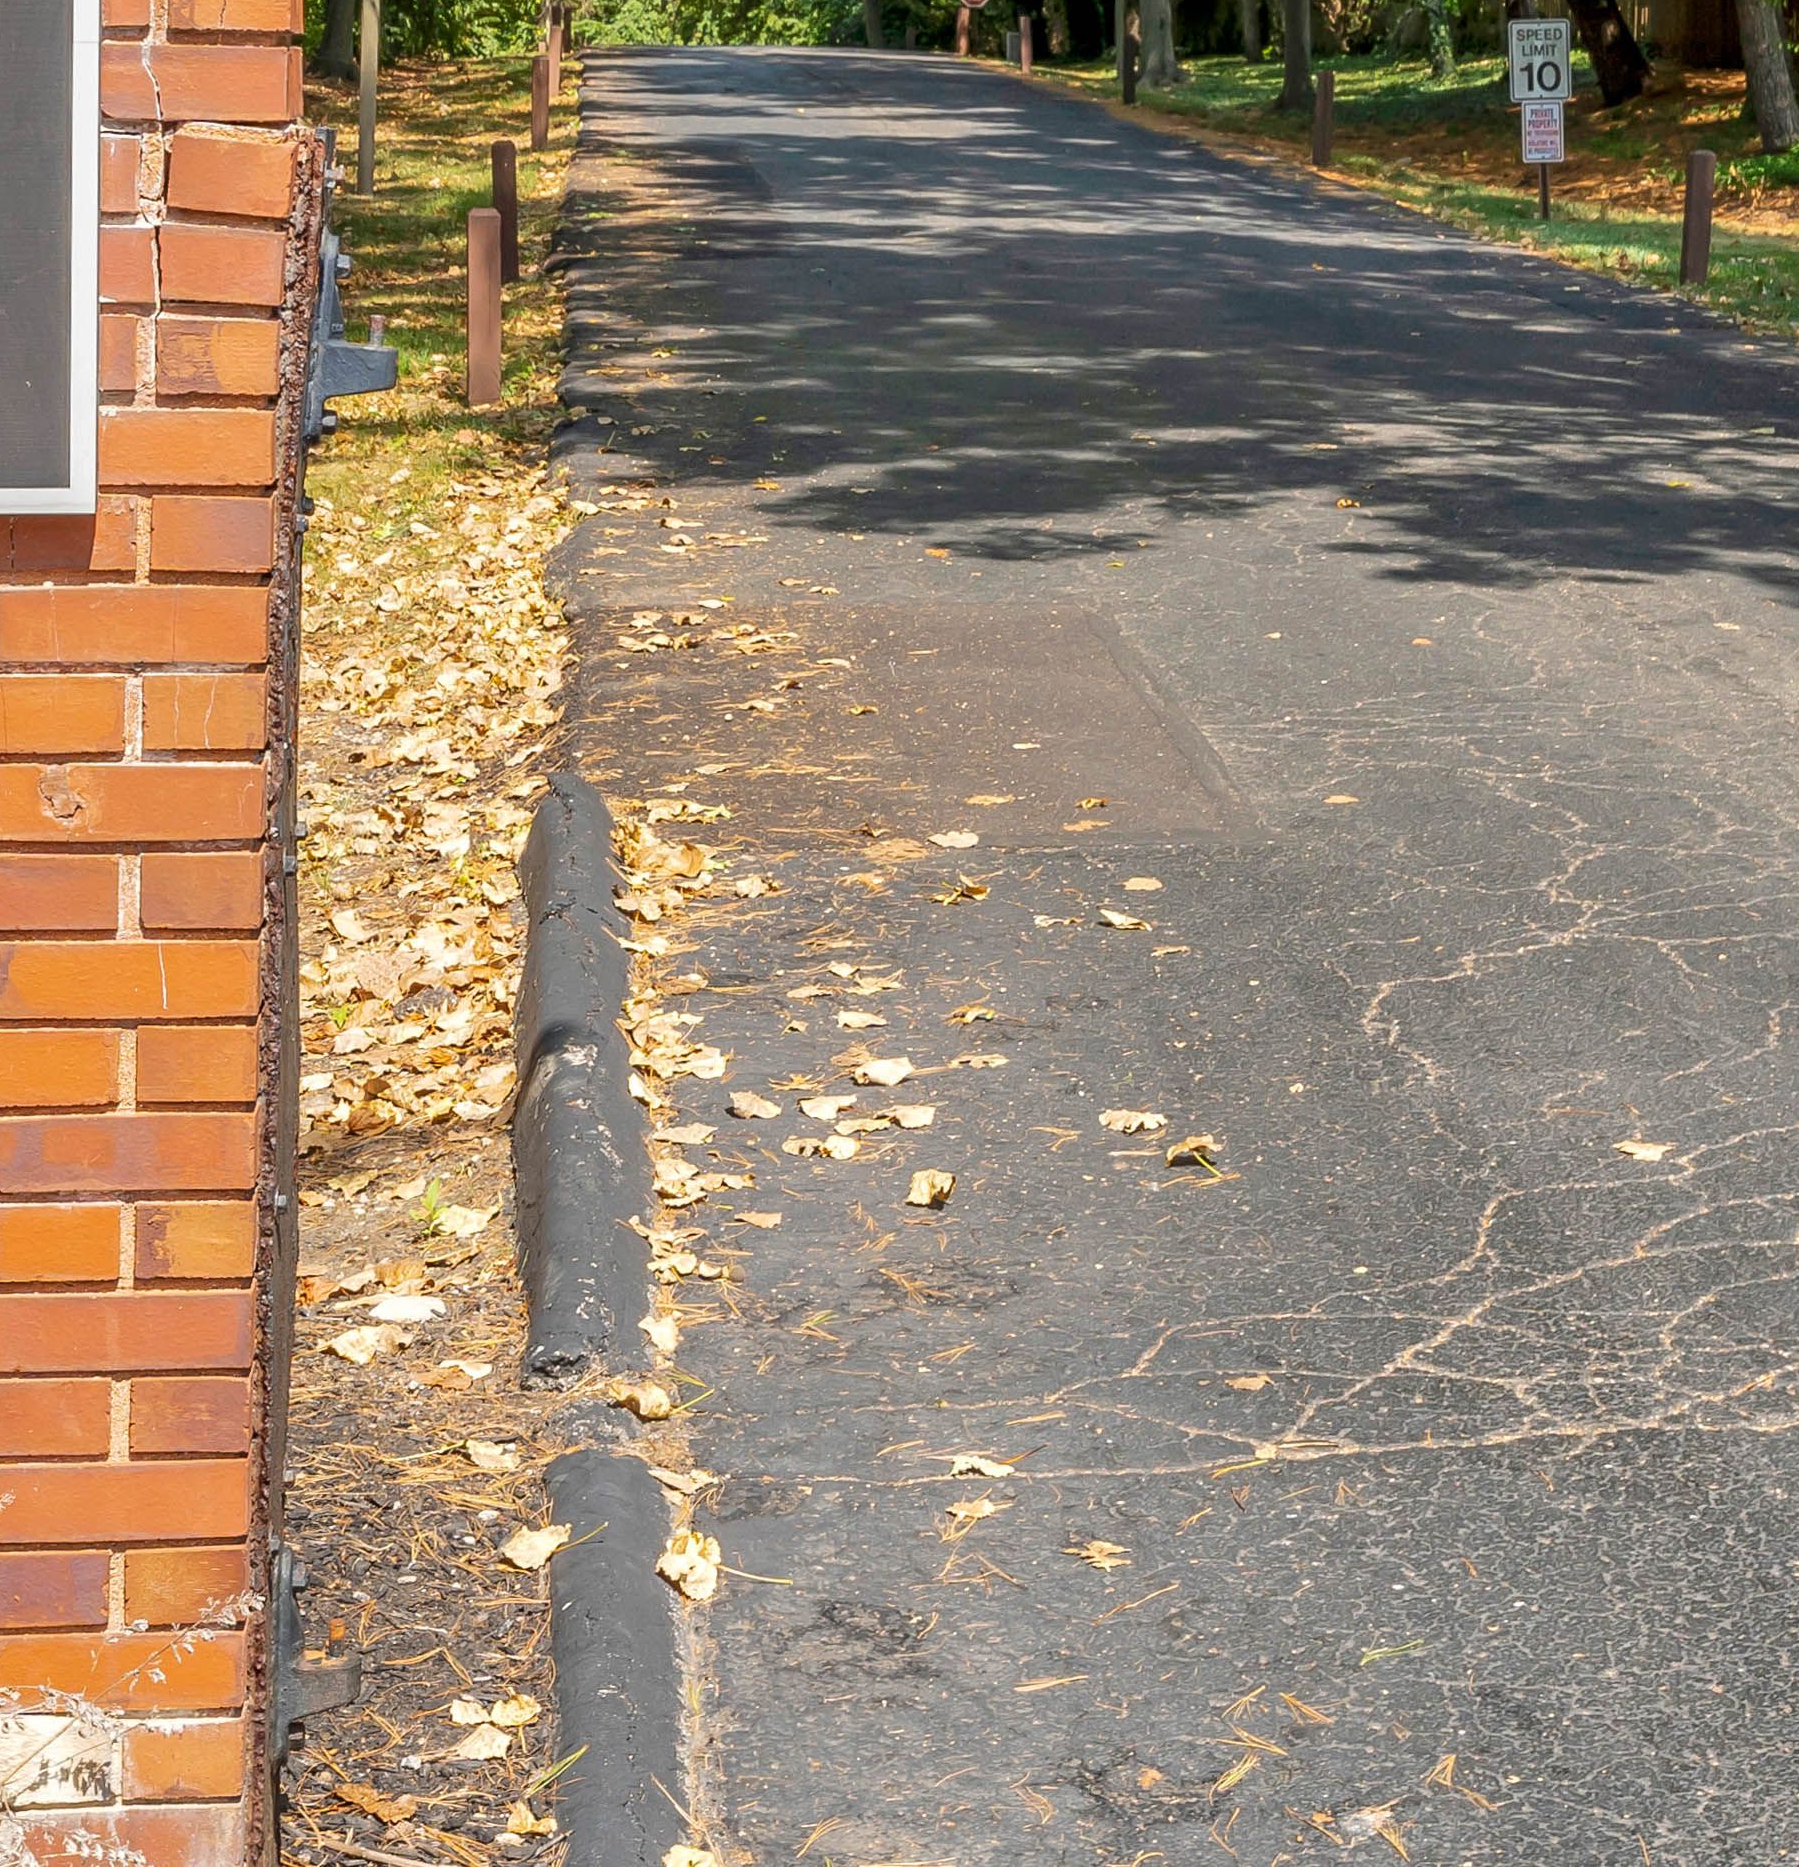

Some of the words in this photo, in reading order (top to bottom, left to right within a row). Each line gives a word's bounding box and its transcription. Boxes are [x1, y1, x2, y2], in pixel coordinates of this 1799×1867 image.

[1516, 28, 1562, 41] SPEED
[1522, 44, 1557, 57] LIMIT
[1519, 61, 1561, 91] 10
